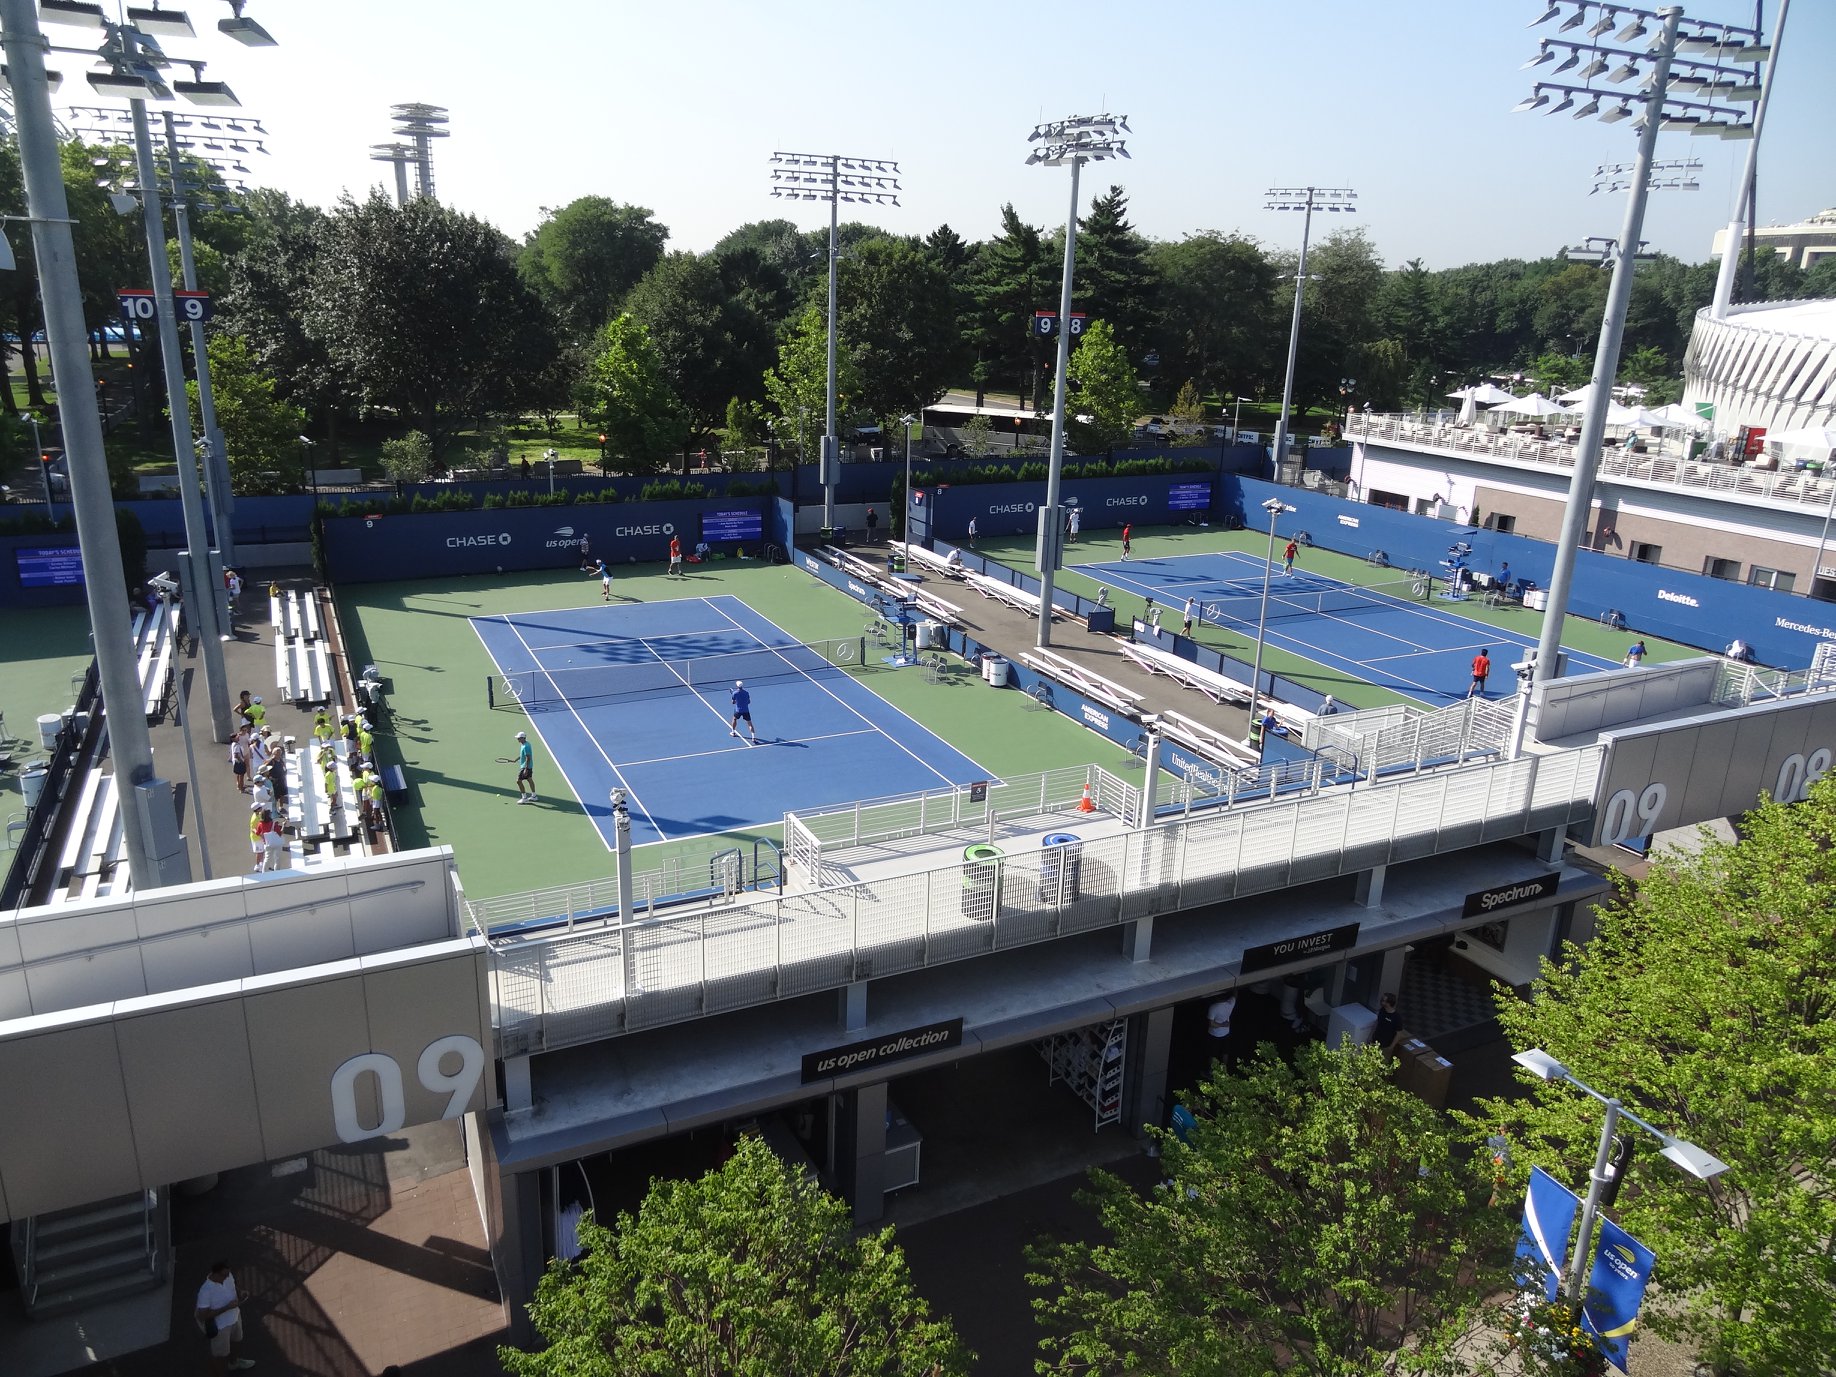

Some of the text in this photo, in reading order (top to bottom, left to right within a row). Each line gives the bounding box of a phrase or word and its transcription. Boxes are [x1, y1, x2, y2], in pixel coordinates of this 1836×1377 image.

[122, 298, 154, 319] 10
[185, 299, 203, 320] 9
[1040, 318, 1051, 333] 9
[1070, 319, 1081, 334] 8
[989, 503, 1024, 514] CHASE
[1106, 496, 1138, 507] CHASE
[366, 520, 374, 528] 9
[615, 524, 661, 537] CHASE
[446, 534, 497, 548] CHASE
[546, 539, 558, 548] us
[1657, 589, 1699, 608] Deloitte.
[1081, 703, 1109, 724] AMERICAN
[1084, 711, 1109, 731] EXPRESS
[1171, 752, 1228, 792] UnitedHealth
[1773, 748, 1832, 804] 08
[1601, 782, 1667, 846] 09
[1481, 883, 1541, 910] Spectrum
[1273, 933, 1333, 955] YOU INVEST
[817, 1030, 949, 1072] us open collection
[331, 1034, 485, 1144] 09
[1603, 1249, 1638, 1279] us open
